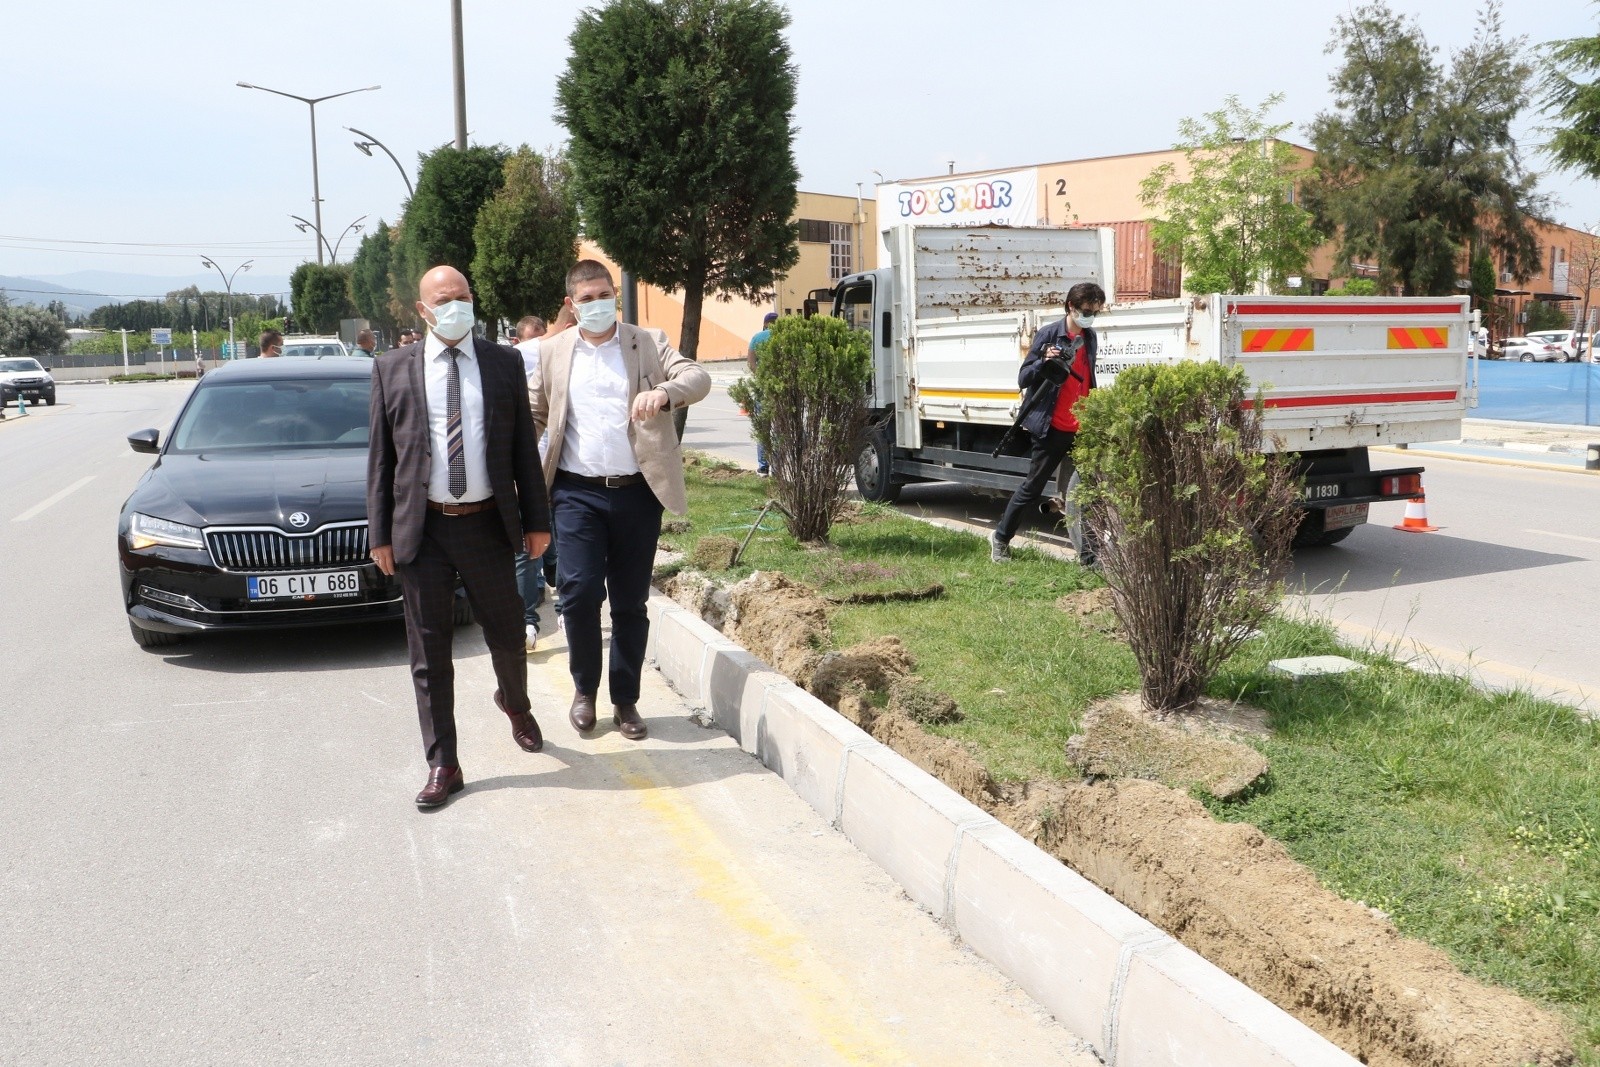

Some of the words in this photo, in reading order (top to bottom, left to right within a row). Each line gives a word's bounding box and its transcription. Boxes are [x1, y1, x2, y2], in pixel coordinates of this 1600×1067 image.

[1055, 178, 1067, 196] 2
[898, 180, 1012, 217] TOYSMAR
[1316, 484, 1339, 498] 1830
[258, 578, 278, 595] 06
[288, 576, 317, 594] CIY
[327, 573, 357, 591] 686
